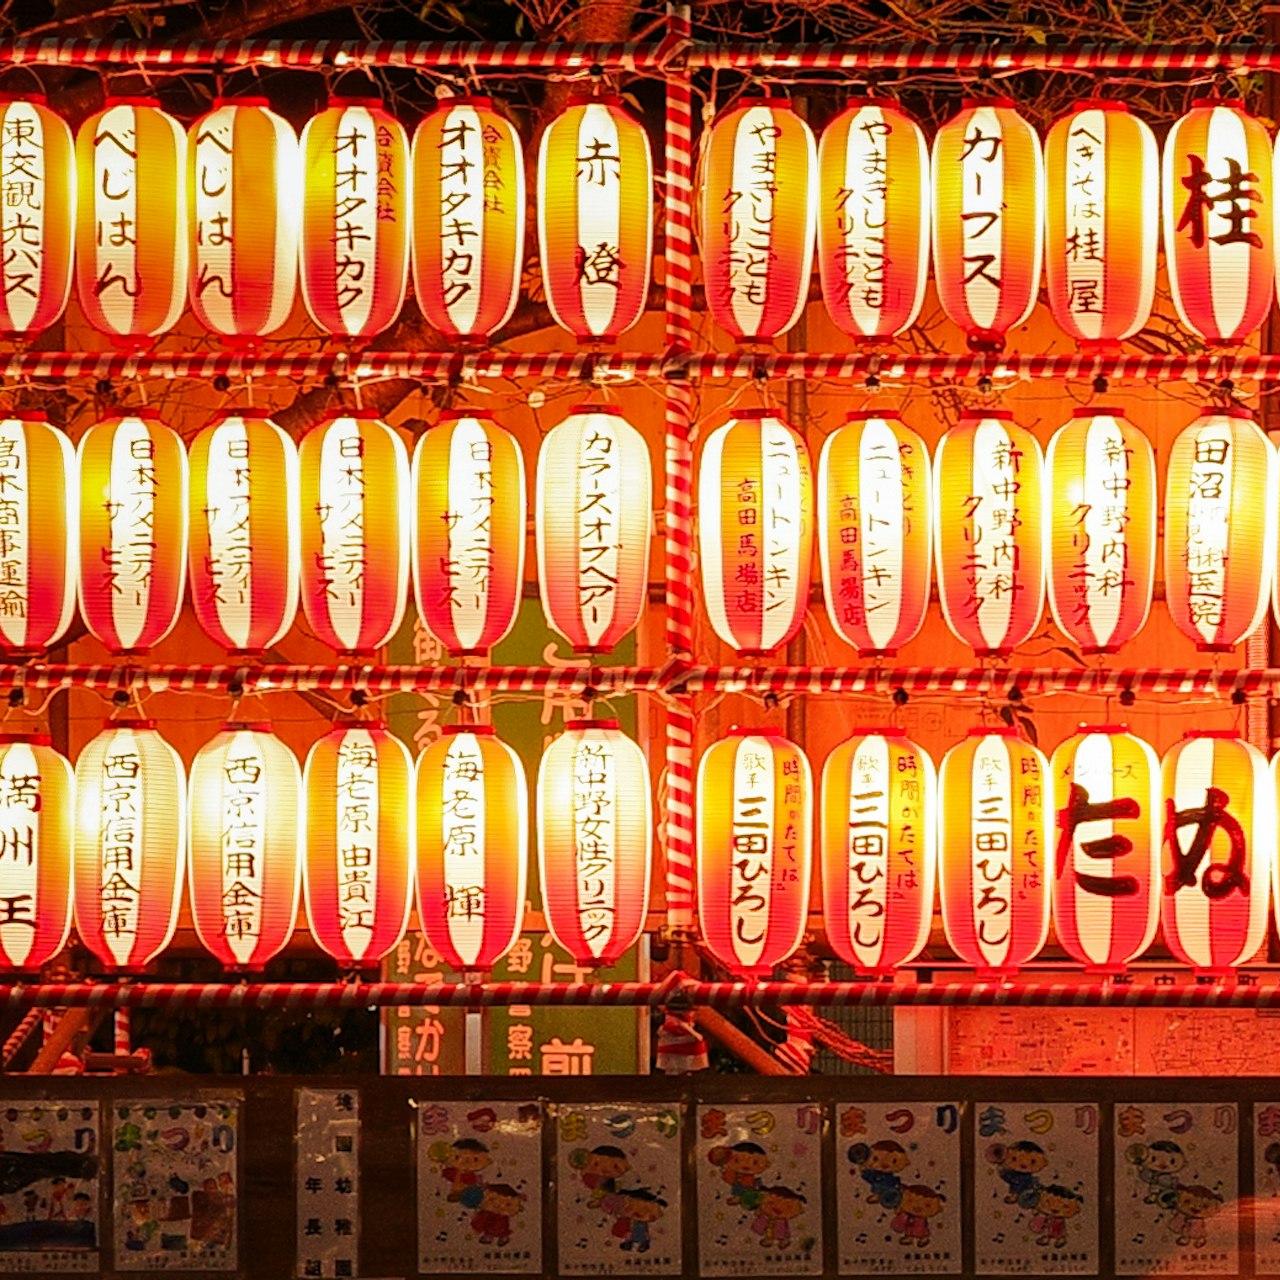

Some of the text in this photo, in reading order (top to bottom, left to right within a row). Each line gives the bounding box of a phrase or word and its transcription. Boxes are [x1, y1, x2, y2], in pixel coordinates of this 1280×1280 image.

[1, 119, 43, 298] 東交観光バス
[94, 128, 142, 298] べじはん
[196, 127, 234, 299] べじはん
[333, 127, 373, 309] オオタキカク
[375, 126, 397, 223] 合資会社
[439, 123, 479, 306] オオタキカク
[482, 125, 504, 215] 合資会社
[742, 122, 782, 305] やまぎしこども
[860, 121, 894, 309] やまぎしこども
[958, 127, 1007, 289] カーブス
[722, 188, 744, 307] クリニック
[835, 187, 856, 305] クリニック
[102, 501, 125, 594] サービス
[203, 504, 226, 604] サービス
[314, 503, 339, 601] サービス
[440, 511, 463, 609] サービス
[736, 478, 758, 613] 高田馬場店
[765, 440, 791, 611] ニュートンキン
[838, 496, 862, 626] 高田馬場店
[864, 444, 894, 613] ニュートンキン
[961, 496, 987, 620] クリニック
[990, 440, 1023, 601] 新中野内科
[1070, 502, 1095, 627] クリニック
[1100, 437, 1135, 597] 新中野内科
[100, 755, 142, 939] 西京信用金庫
[222, 758, 264, 937] 西京信用金庫
[573, 746, 617, 942] 新中野女性クリニック
[422, 1105, 541, 1134] まつり
[558, 1110, 678, 1142] まつり
[701, 1107, 822, 1140] まつり
[839, 1105, 958, 1138] まつり
[978, 1105, 1098, 1137] まつり
[1117, 1105, 1237, 1137] まつり
[305, 1178, 322, 1276] 年長組
